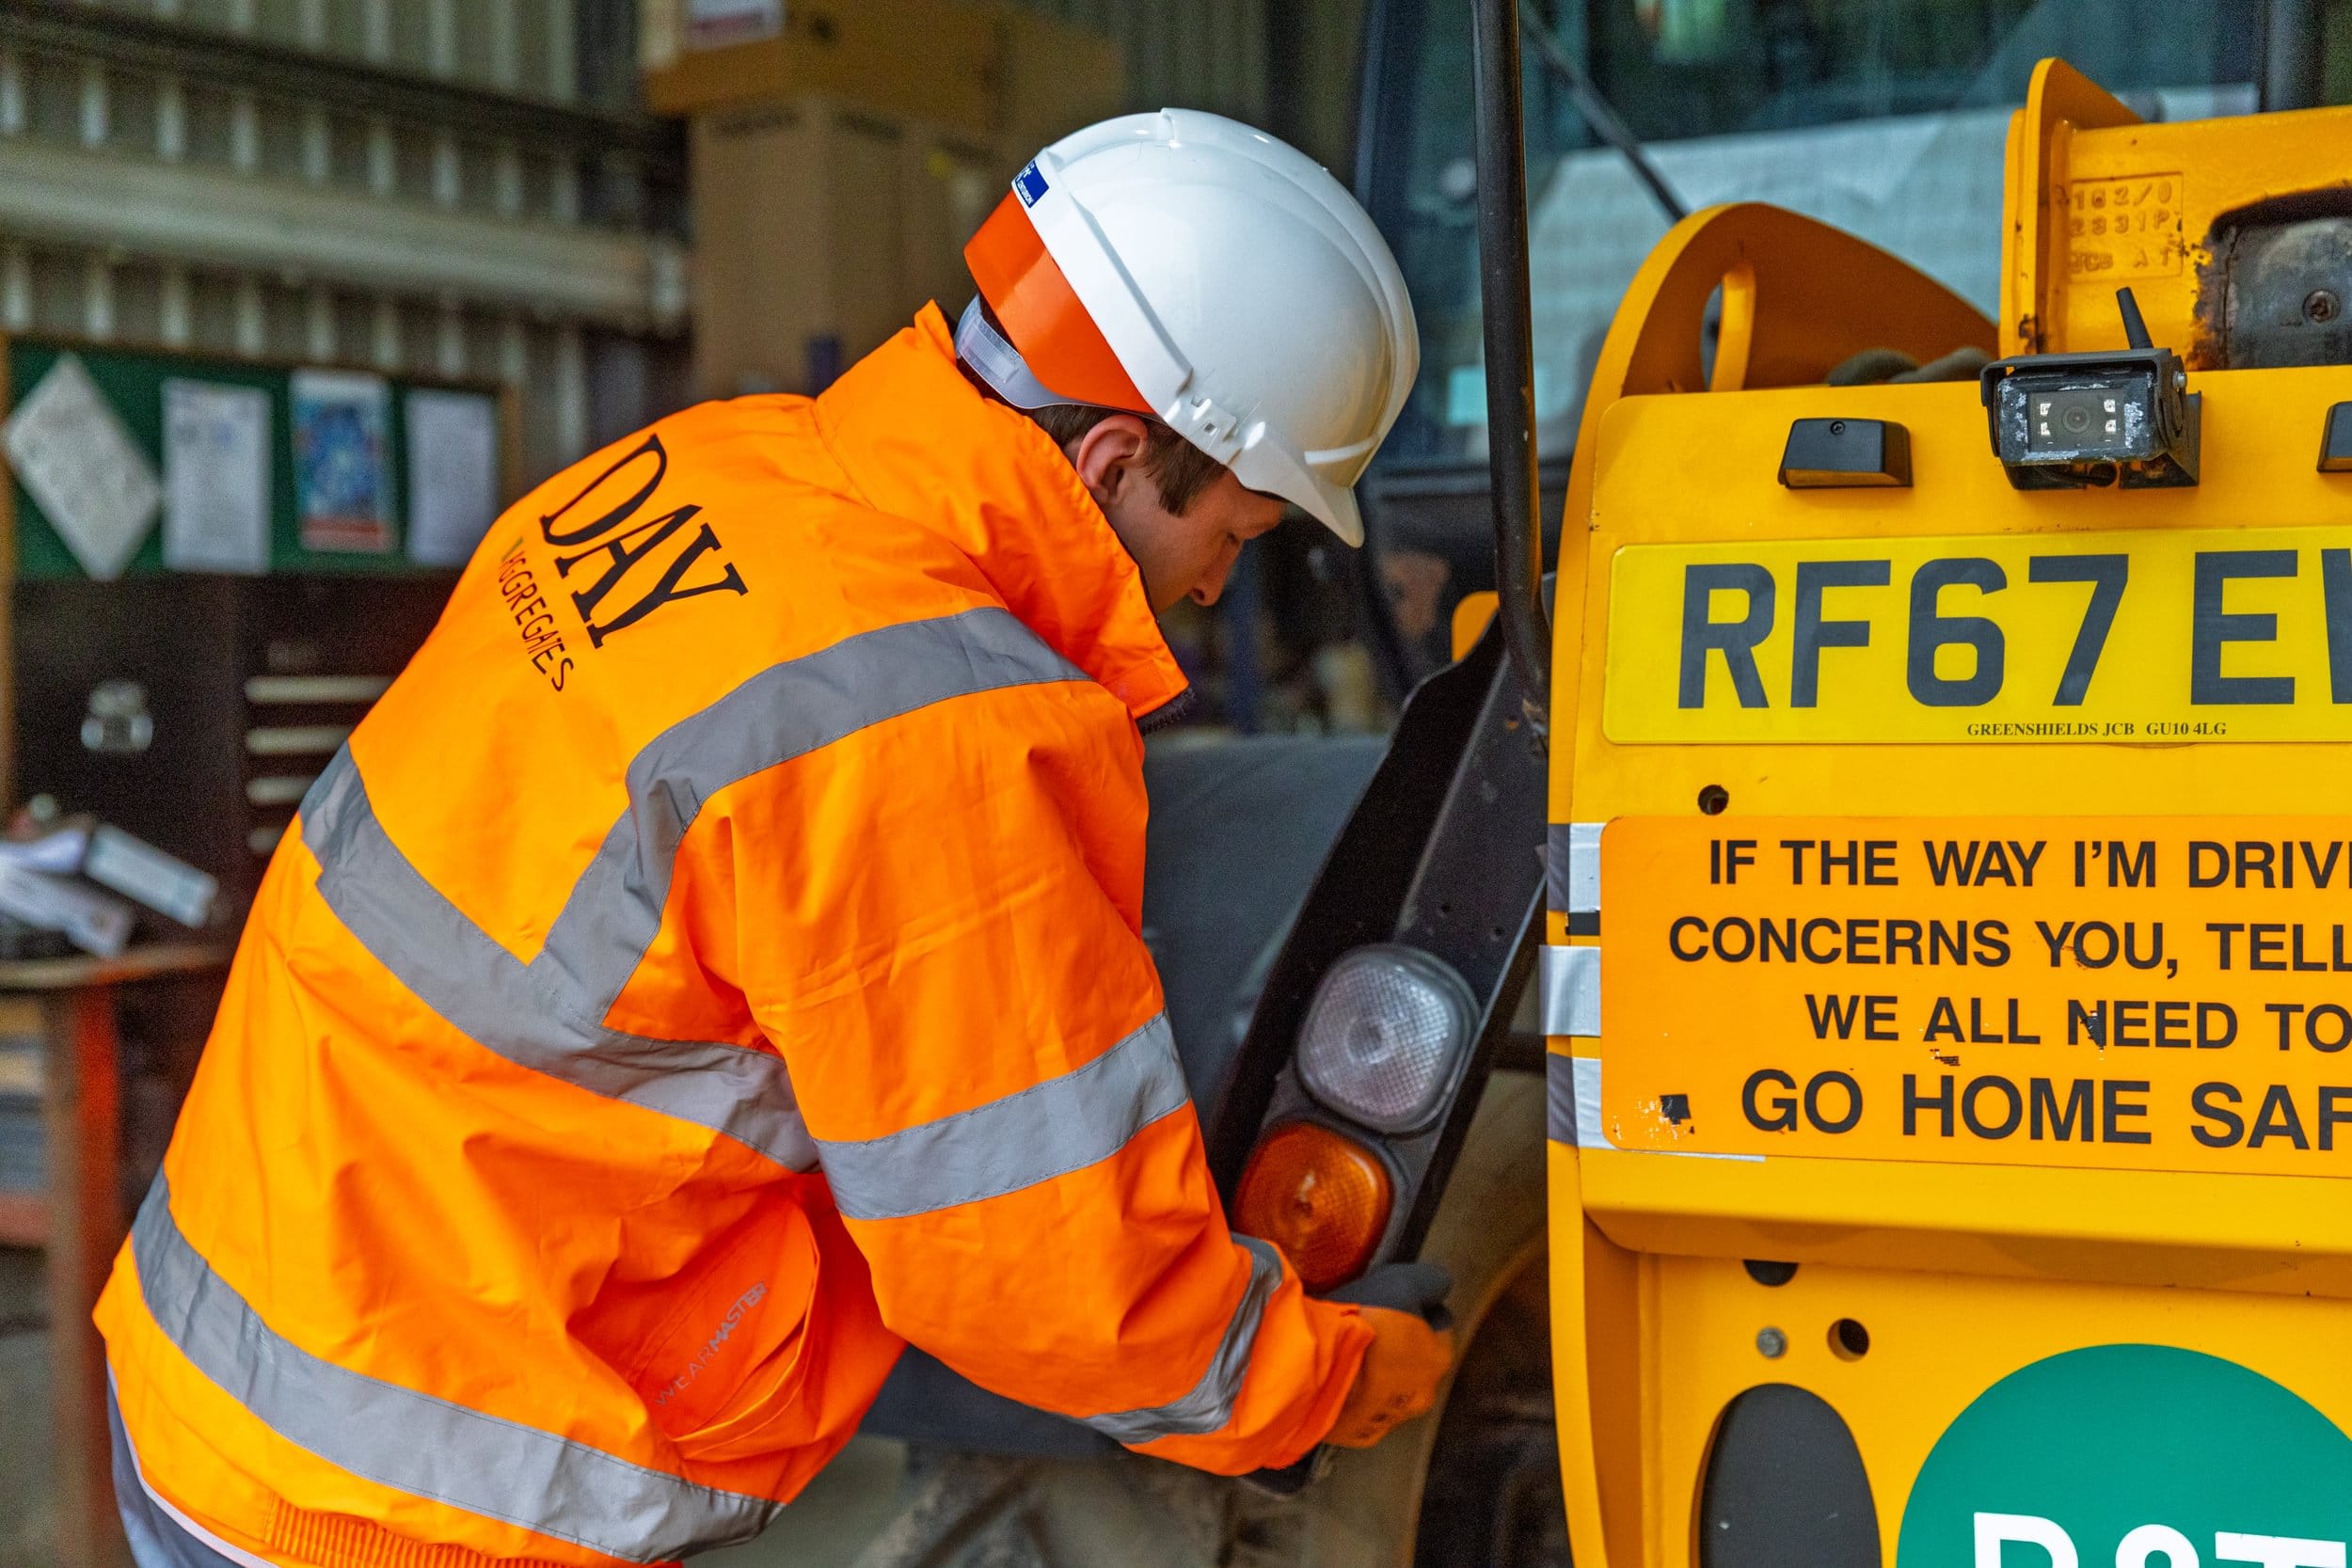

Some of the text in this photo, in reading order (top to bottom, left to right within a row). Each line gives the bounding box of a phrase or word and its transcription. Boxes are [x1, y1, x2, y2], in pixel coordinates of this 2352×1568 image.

[538, 433, 749, 649] DAY
[1677, 553, 2130, 709] RF67
[1966, 722, 2227, 736] GREENSHIELDS JCB GU10 4LG
[1710, 839, 2352, 889] IF THE WAY I'M DRIV
[1669, 916, 2352, 979] CONCERNS YOU, TELL
[1804, 993, 2352, 1053] WE ALL NEED TO
[1741, 1069, 1864, 1134] GO
[1902, 1073, 2152, 1145] HOME
